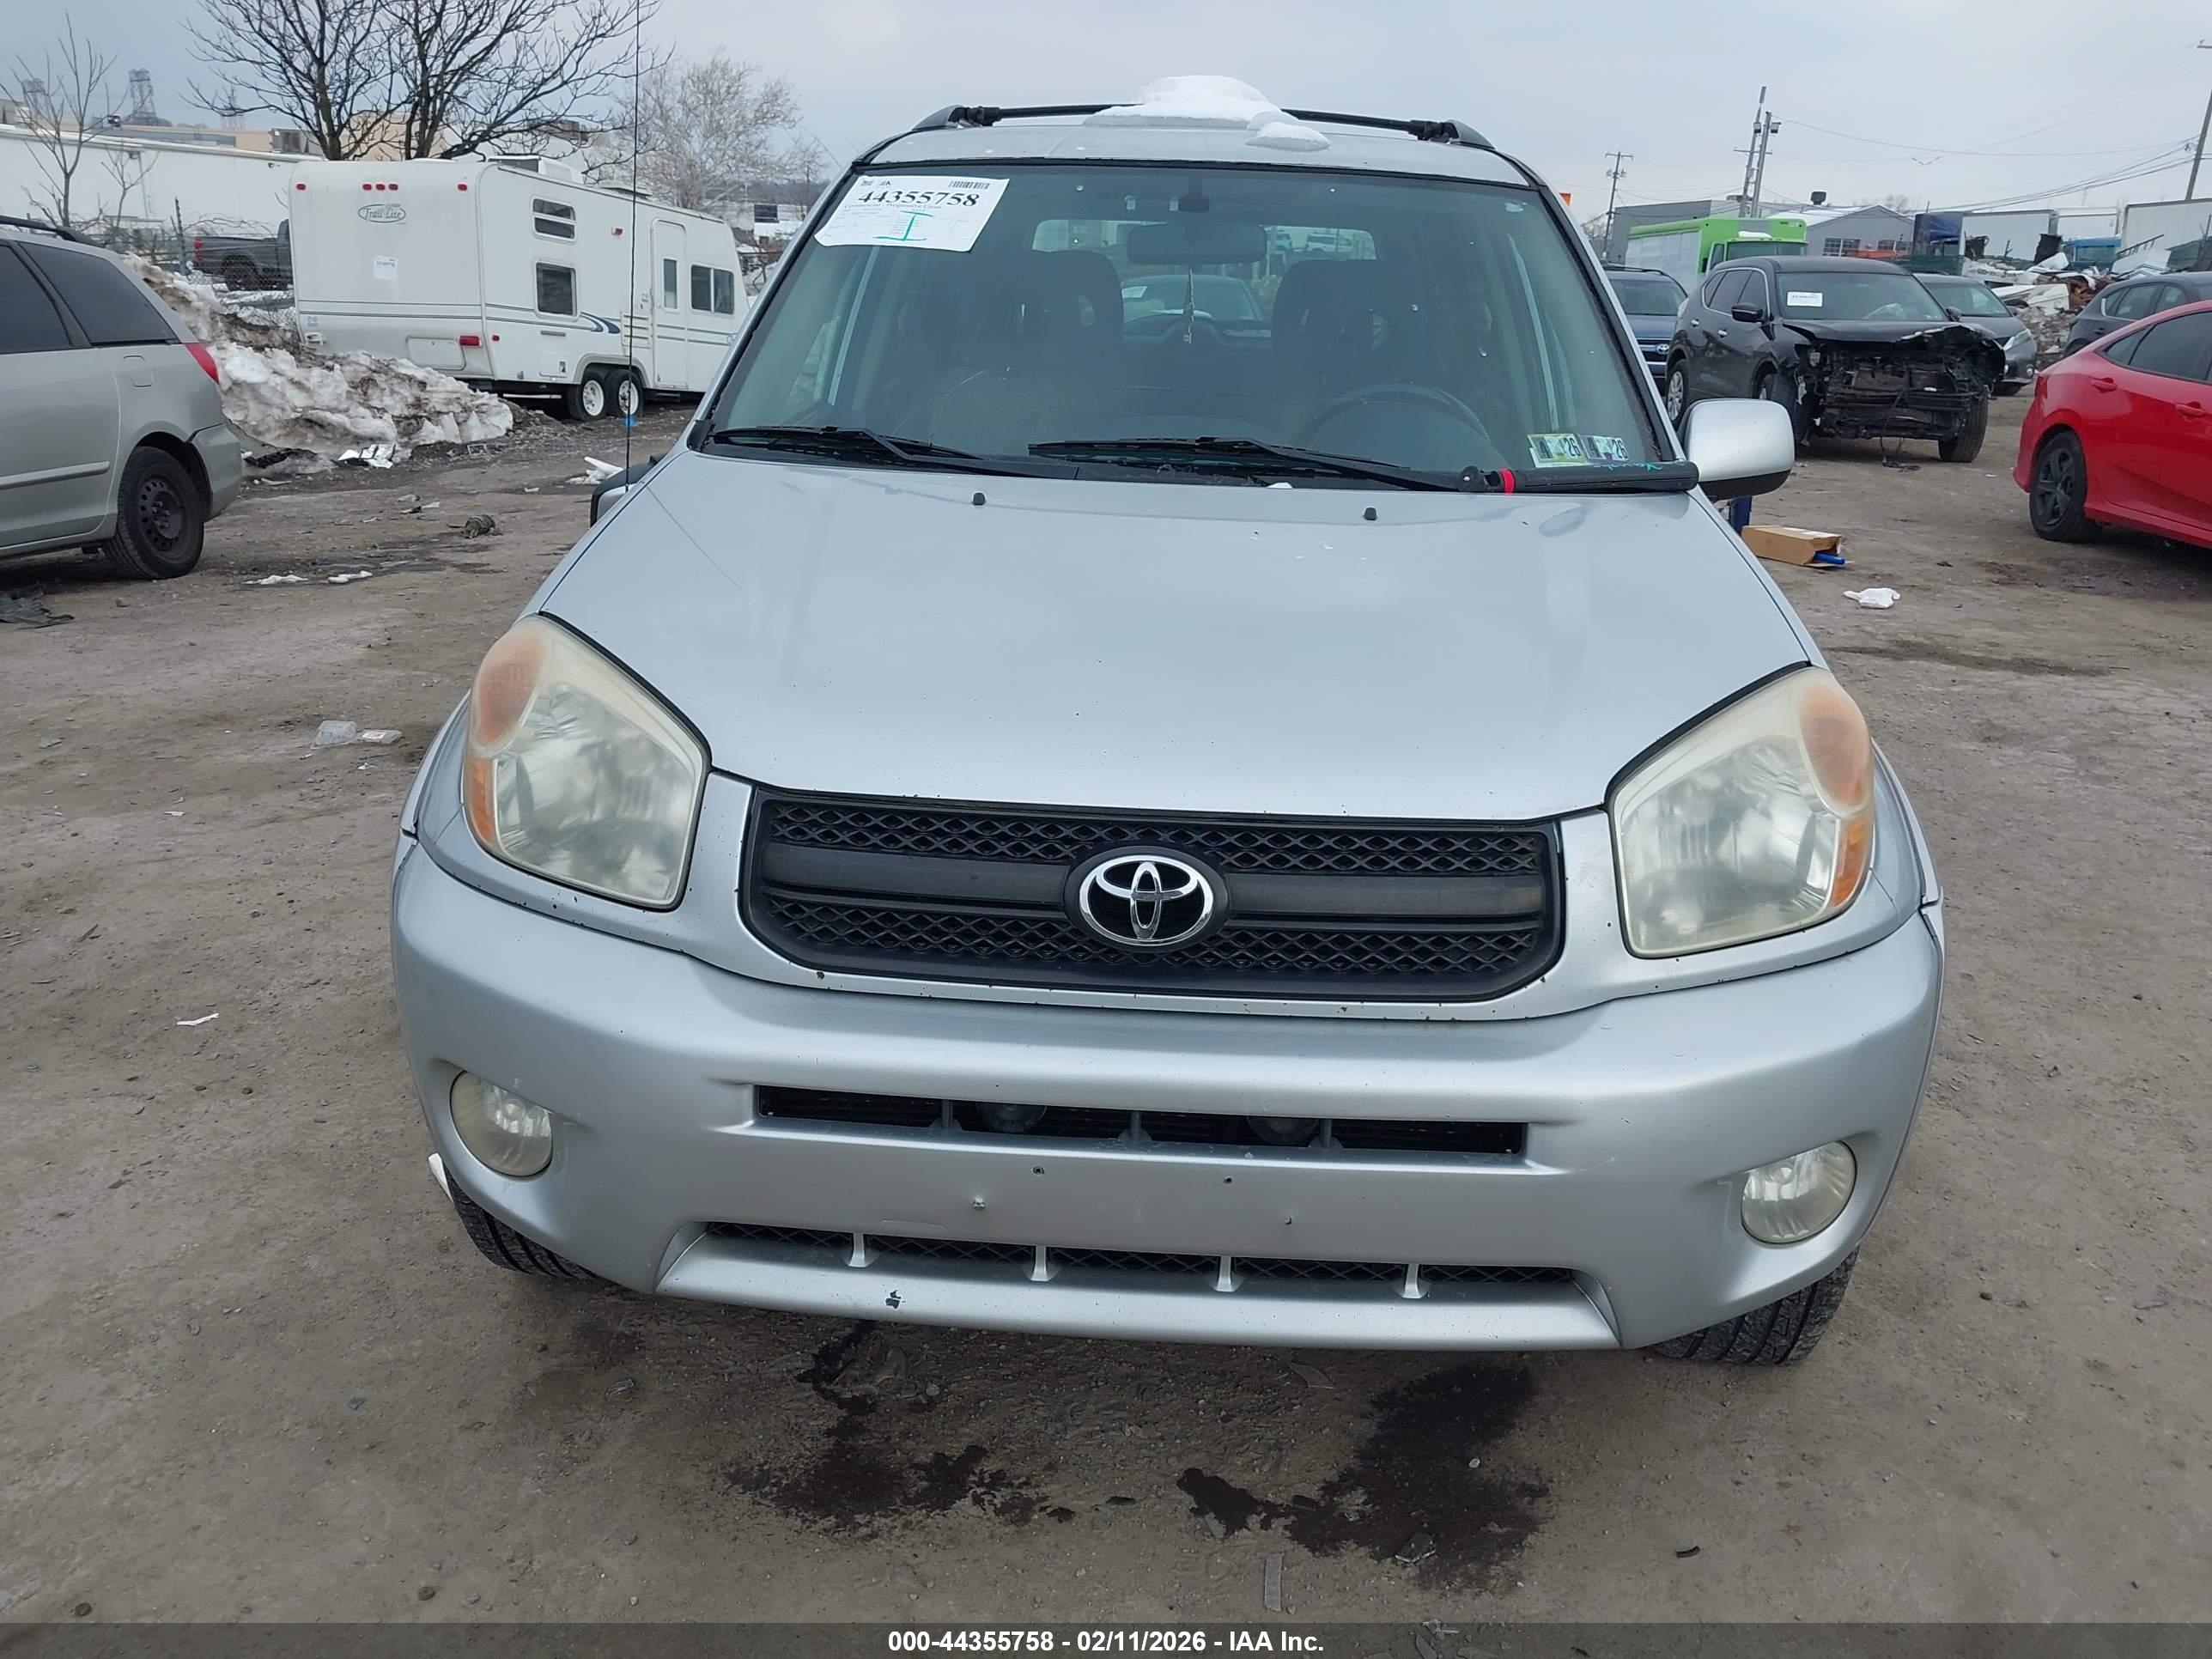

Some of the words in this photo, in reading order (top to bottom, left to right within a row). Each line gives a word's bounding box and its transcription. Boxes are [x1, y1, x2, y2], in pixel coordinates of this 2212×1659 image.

[857, 190, 980, 207] 44355758
[1564, 437, 1582, 458] 26
[1611, 439, 1629, 459] 26
